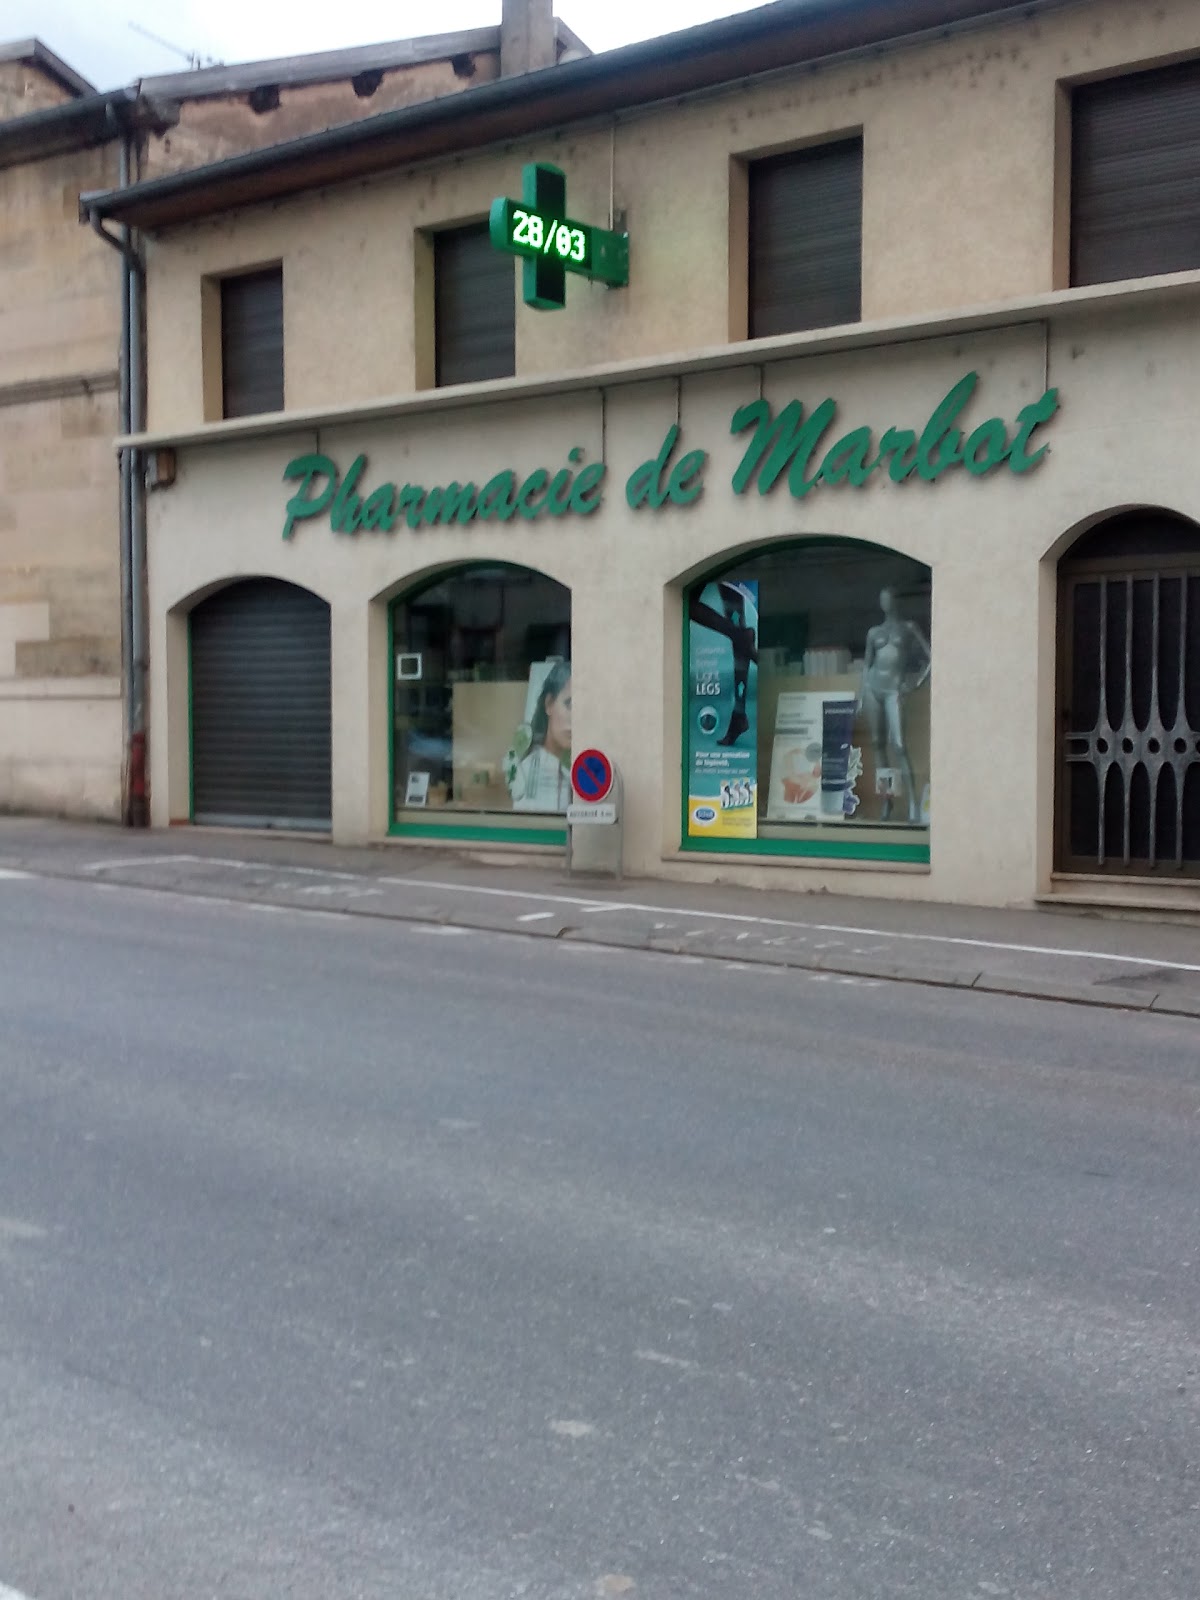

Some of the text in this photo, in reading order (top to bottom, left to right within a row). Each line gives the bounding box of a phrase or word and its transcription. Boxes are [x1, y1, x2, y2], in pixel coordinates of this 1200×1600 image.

[512, 209, 586, 262] 28/03
[283, 371, 1059, 540] Pharmacie de Marbot
[695, 683, 720, 696] LEGS
